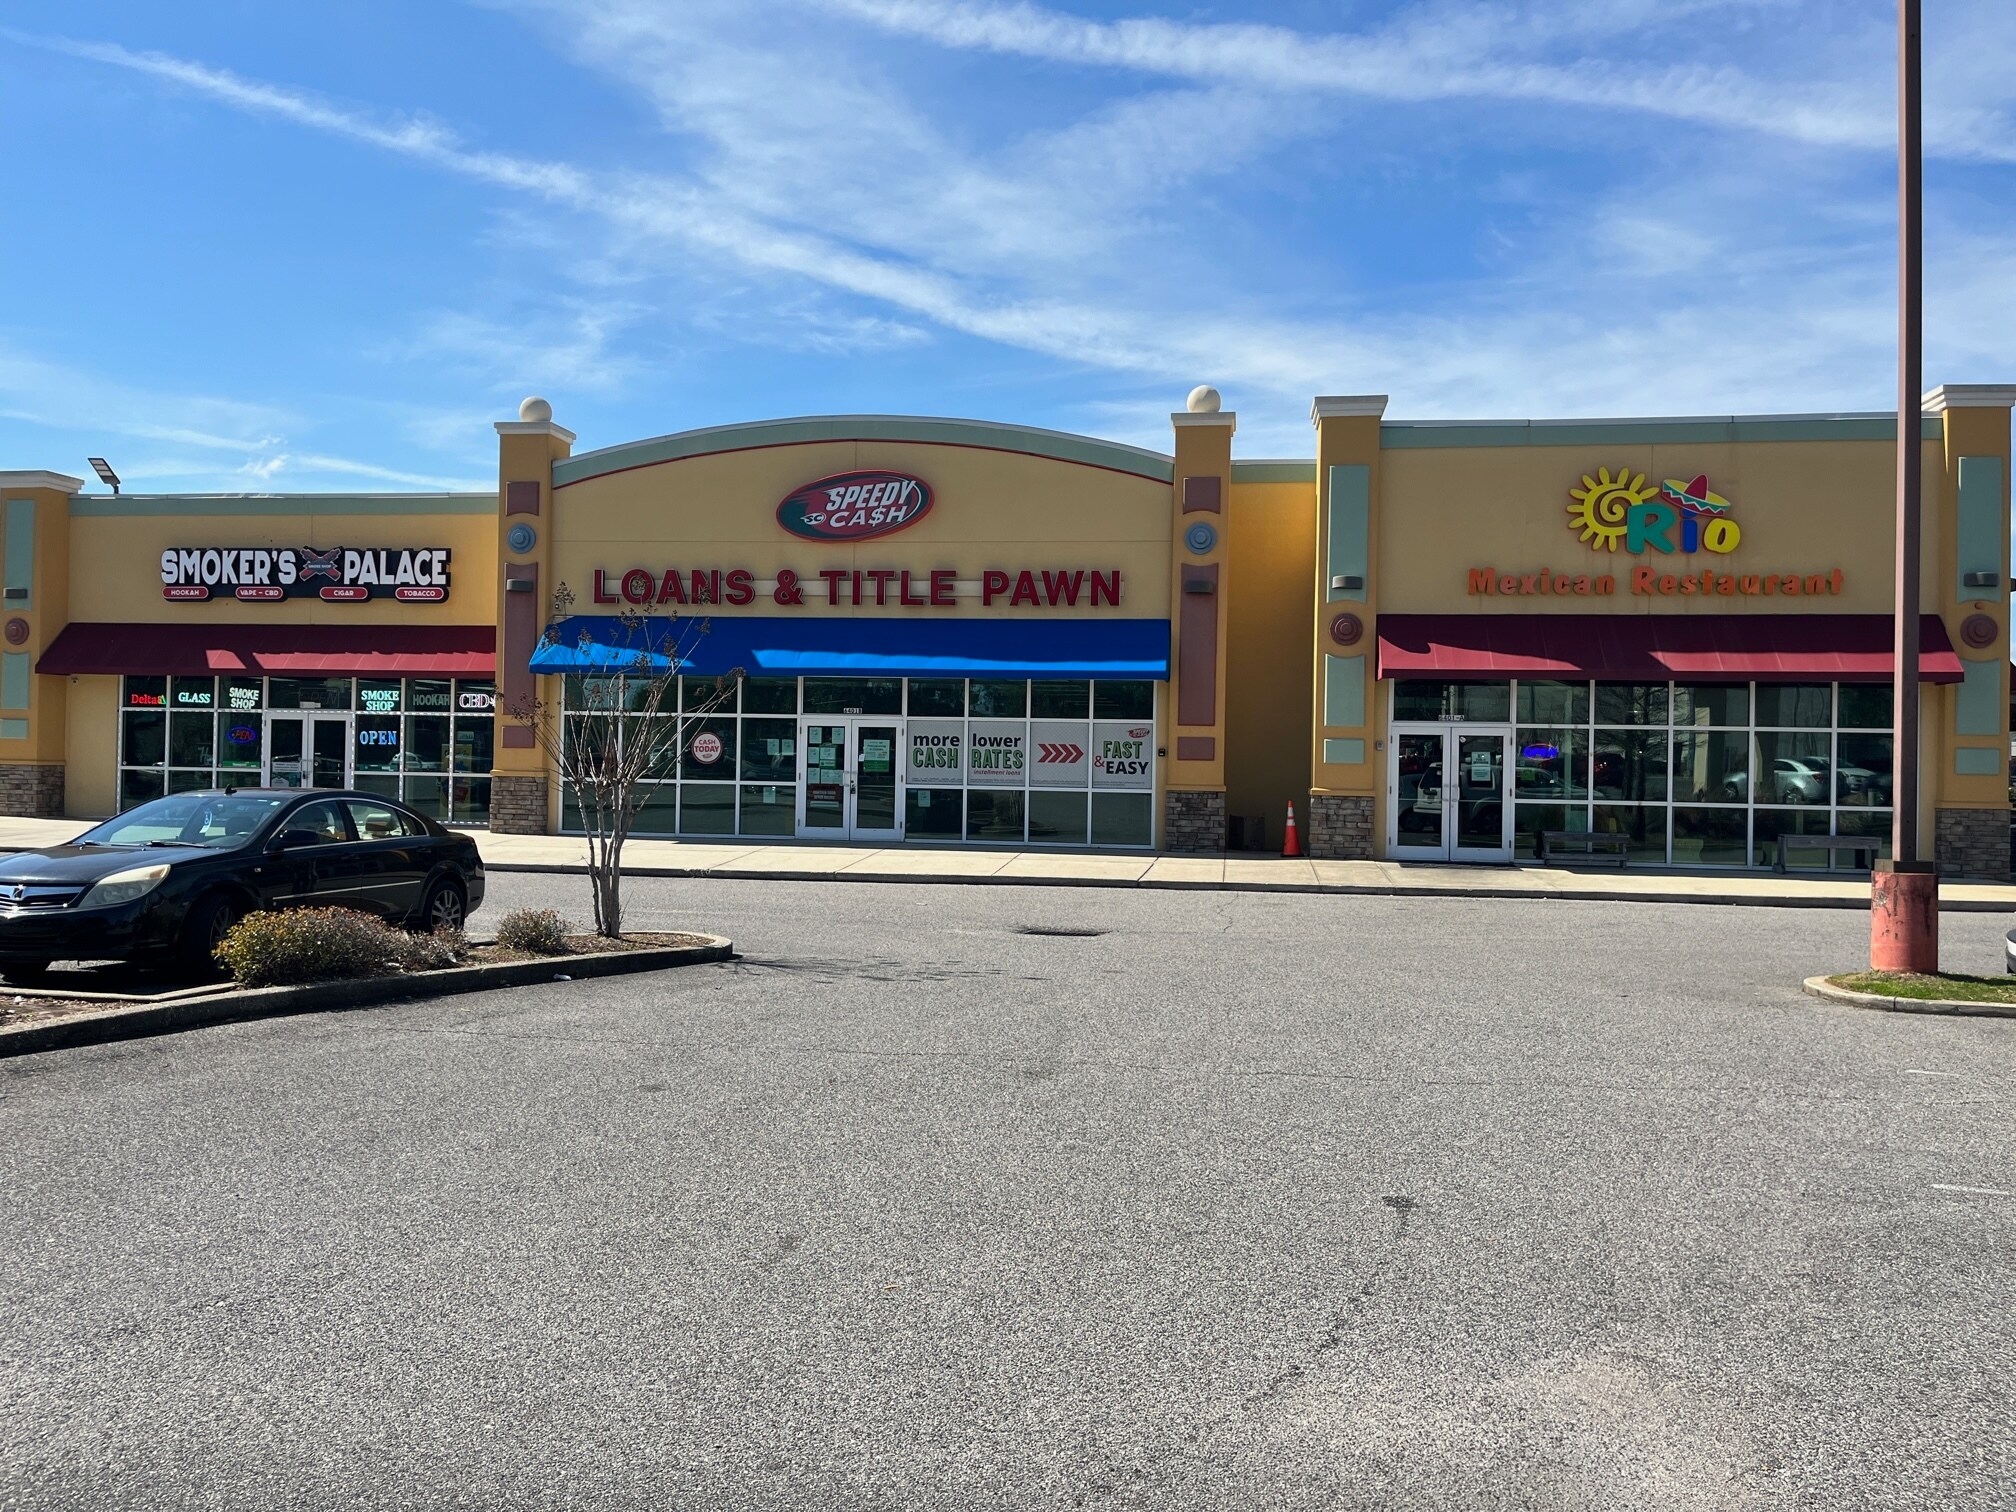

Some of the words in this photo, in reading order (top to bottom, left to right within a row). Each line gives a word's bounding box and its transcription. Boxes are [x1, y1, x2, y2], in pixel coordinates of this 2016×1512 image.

[824, 480, 916, 512] SPEEDY
[829, 505, 908, 528] CA$H
[161, 550, 297, 585] SMOKER'S
[343, 550, 447, 586] PALACE
[593, 569, 755, 606] LOANS
[773, 569, 804, 606] &
[819, 570, 957, 606] TITLE
[982, 570, 1121, 606] PAWN
[1467, 567, 1615, 596] Mexican
[1632, 566, 1845, 596] Restaurant
[178, 692, 211, 704] GLASS
[229, 687, 260, 700] SMOKE
[361, 690, 400, 701] SMOKE
[459, 693, 490, 708] CBD
[230, 698, 256, 709] SHOP
[366, 701, 395, 711] SHOP
[359, 730, 397, 745] OPEN
[913, 735, 960, 746] more
[972, 733, 1022, 747] lower
[912, 747, 959, 768] CASH
[1103, 741, 1143, 759] FAST
[971, 749, 1023, 769] RATES
[1094, 756, 1105, 767] &
[1106, 761, 1149, 774] EASY
